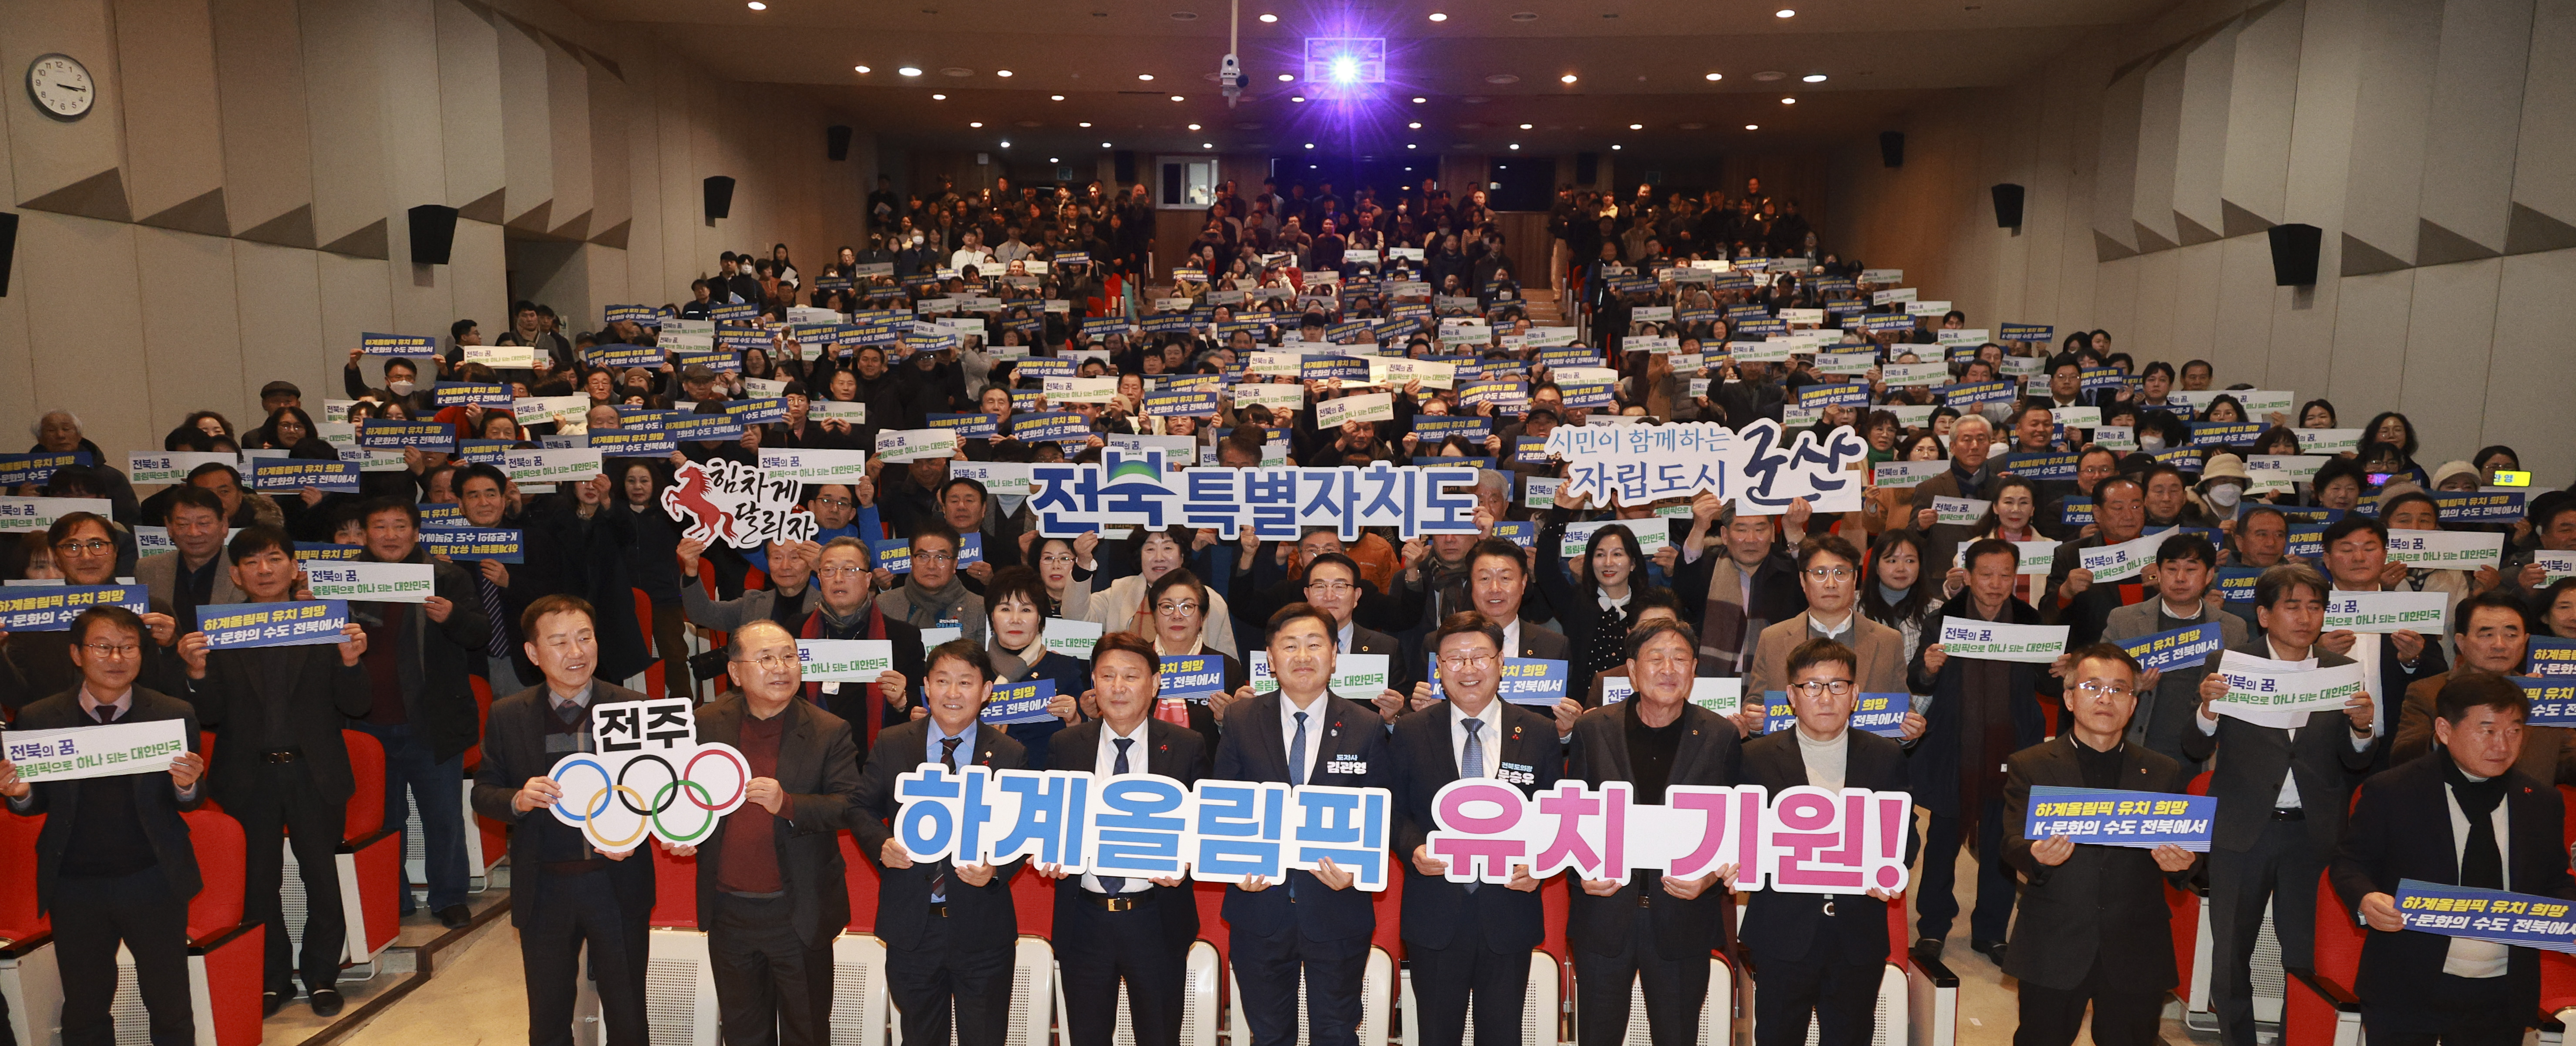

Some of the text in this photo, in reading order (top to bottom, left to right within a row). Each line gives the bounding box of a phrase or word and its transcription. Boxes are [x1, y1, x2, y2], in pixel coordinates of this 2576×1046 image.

[1046, 382, 1074, 391] 전북의 꿈,
[1046, 391, 1070, 399] 올림픽으로
[1093, 388, 1114, 396] 대한민국
[1147, 394, 1207, 406] 하계올림픽 유치 희망
[1147, 402, 1215, 414] K-문화의 수도 전북에서
[1550, 427, 1731, 454] 시민이 함께하는
[258, 464, 344, 475] 하계올림픽 유치 희망
[508, 456, 544, 468] 전북의 꿈,
[762, 456, 802, 468] 전북의 꿈,
[1743, 425, 1861, 506] 군산
[510, 467, 541, 479] 올림픽으로
[543, 466, 556, 476] 하나
[571, 462, 598, 472] 대한민국
[768, 471, 797, 479] 림픽으로
[799, 468, 815, 477] 하나
[831, 464, 861, 475] 대한민국
[257, 474, 356, 486] K-문화의 수도 전북에서
[709, 462, 798, 503] 힘차게
[1573, 460, 1725, 501] 자립도시
[1030, 451, 1476, 536] 전북특별자치도
[735, 500, 815, 544] 달리자
[418, 532, 518, 543] K-문화의 수도 전북에서
[2413, 539, 2426, 550] 꿈,
[430, 544, 518, 555] 하계올림픽 유치 희망
[2387, 549, 2498, 563] 림픽으로 하나 되는 대한민국
[312, 569, 360, 583] 전북의 꿈,
[313, 580, 430, 597] 올림픽으로 하나 되는 대한민국
[2344, 600, 2360, 613] 꿈,
[204, 605, 326, 631] 하계올림픽 유치 희망
[2325, 610, 2440, 626] 픽으로 하나 되는 대한민국
[206, 617, 345, 647] K-문화의 수도 전북에서
[1945, 628, 1993, 642] 전북의 꿈,
[1066, 638, 1097, 648] 대한민국
[1943, 641, 2062, 653] 올림픽으로 하나 되는 대한민국
[799, 648, 813, 662] 꿈,
[811, 658, 888, 674] 하나 되는 대한민국
[1160, 659, 1204, 675] 유치 희망
[1500, 664, 1547, 677] 유치 희망
[1173, 673, 1220, 689] 전북에서
[1344, 673, 1384, 686] 대한민국
[1513, 679, 1563, 692] 전북에서
[2261, 678, 2278, 693] 꿈,
[991, 686, 1036, 702] 유치 희망
[2273, 692, 2295, 705] 하나
[2298, 693, 2317, 702] 되는
[2320, 682, 2361, 700] 대한민국
[981, 696, 1052, 717] 수도 전북에서
[1697, 697, 1736, 709] 대한민국
[1862, 698, 1888, 711] 희망
[1853, 712, 1904, 727] 전북에서
[599, 705, 689, 752] 전주
[10, 739, 79, 761] 전북의 꿈,
[77, 753, 103, 769] 하나
[107, 751, 128, 763] 되는
[130, 739, 182, 760] 대한민국
[1327, 761, 1367, 774] 김관영
[1502, 762, 1533, 772] 전북도의장
[1498, 769, 1534, 785] 문승우
[2035, 800, 2189, 817] 하계올림픽 유치 희망
[902, 770, 1383, 884] 하계올림픽
[2033, 820, 2208, 836] K-문화의 수도 전북에서
[1434, 785, 1903, 888] 유치 기원!
[2402, 896, 2569, 918] 하계올림픽 유치 희망
[2401, 913, 2471, 929] K-문화의
[2473, 917, 2510, 931] 수도
